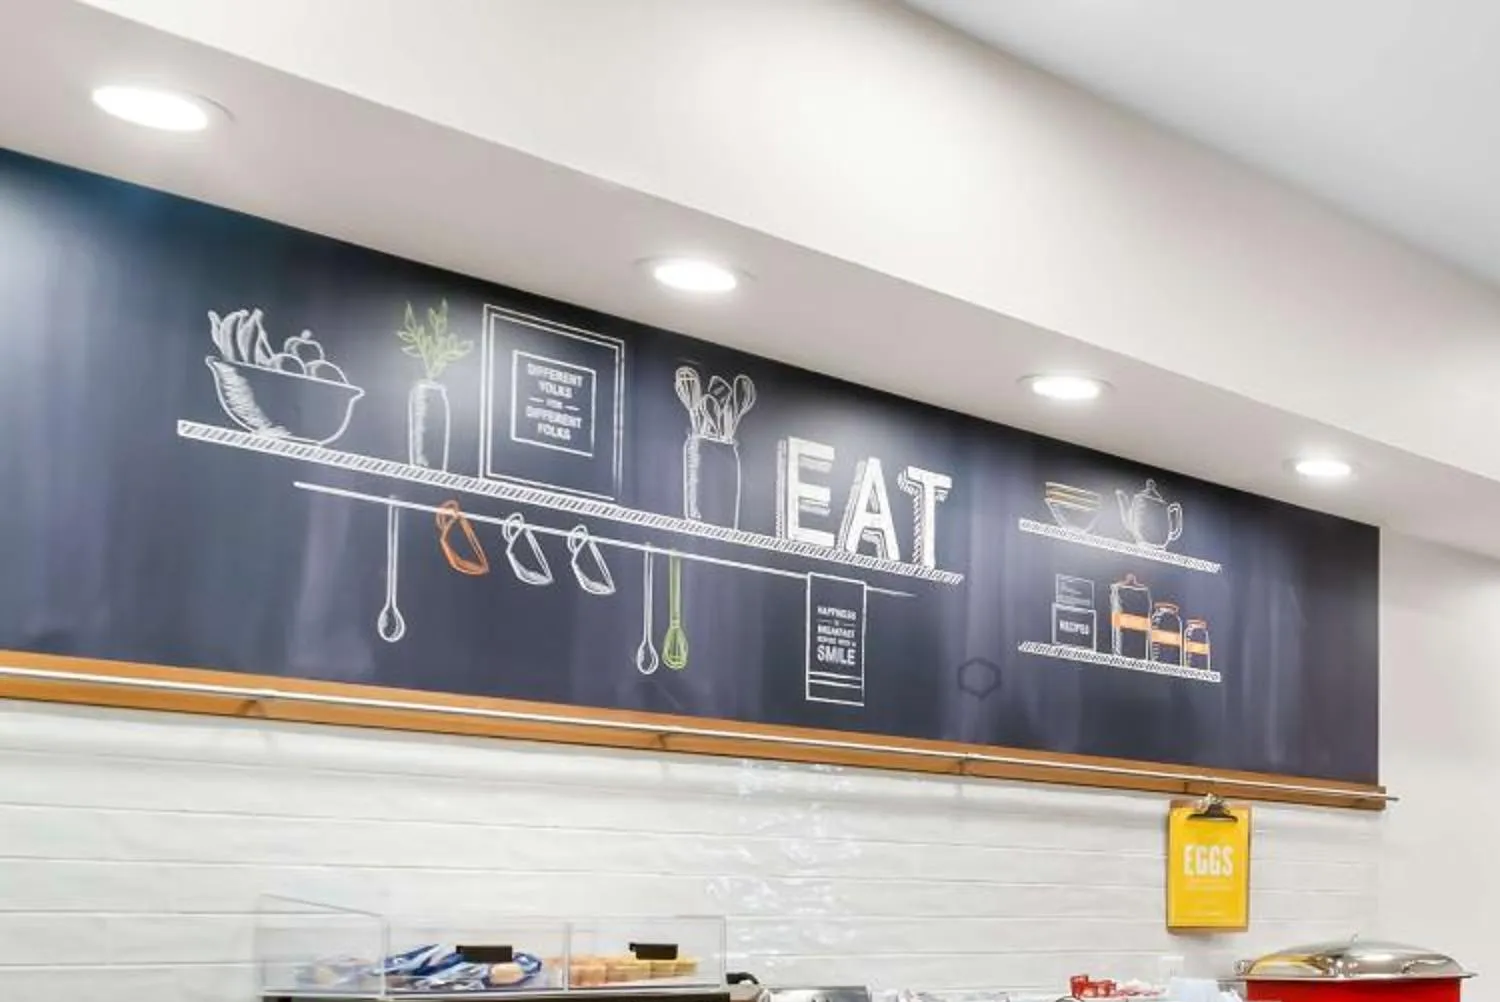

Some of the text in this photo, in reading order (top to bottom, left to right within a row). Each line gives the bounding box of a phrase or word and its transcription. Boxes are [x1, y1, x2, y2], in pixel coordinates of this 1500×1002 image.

[777, 436, 953, 570] EAT
[817, 645, 857, 665] SMILE
[1183, 844, 1234, 877] EGGS
